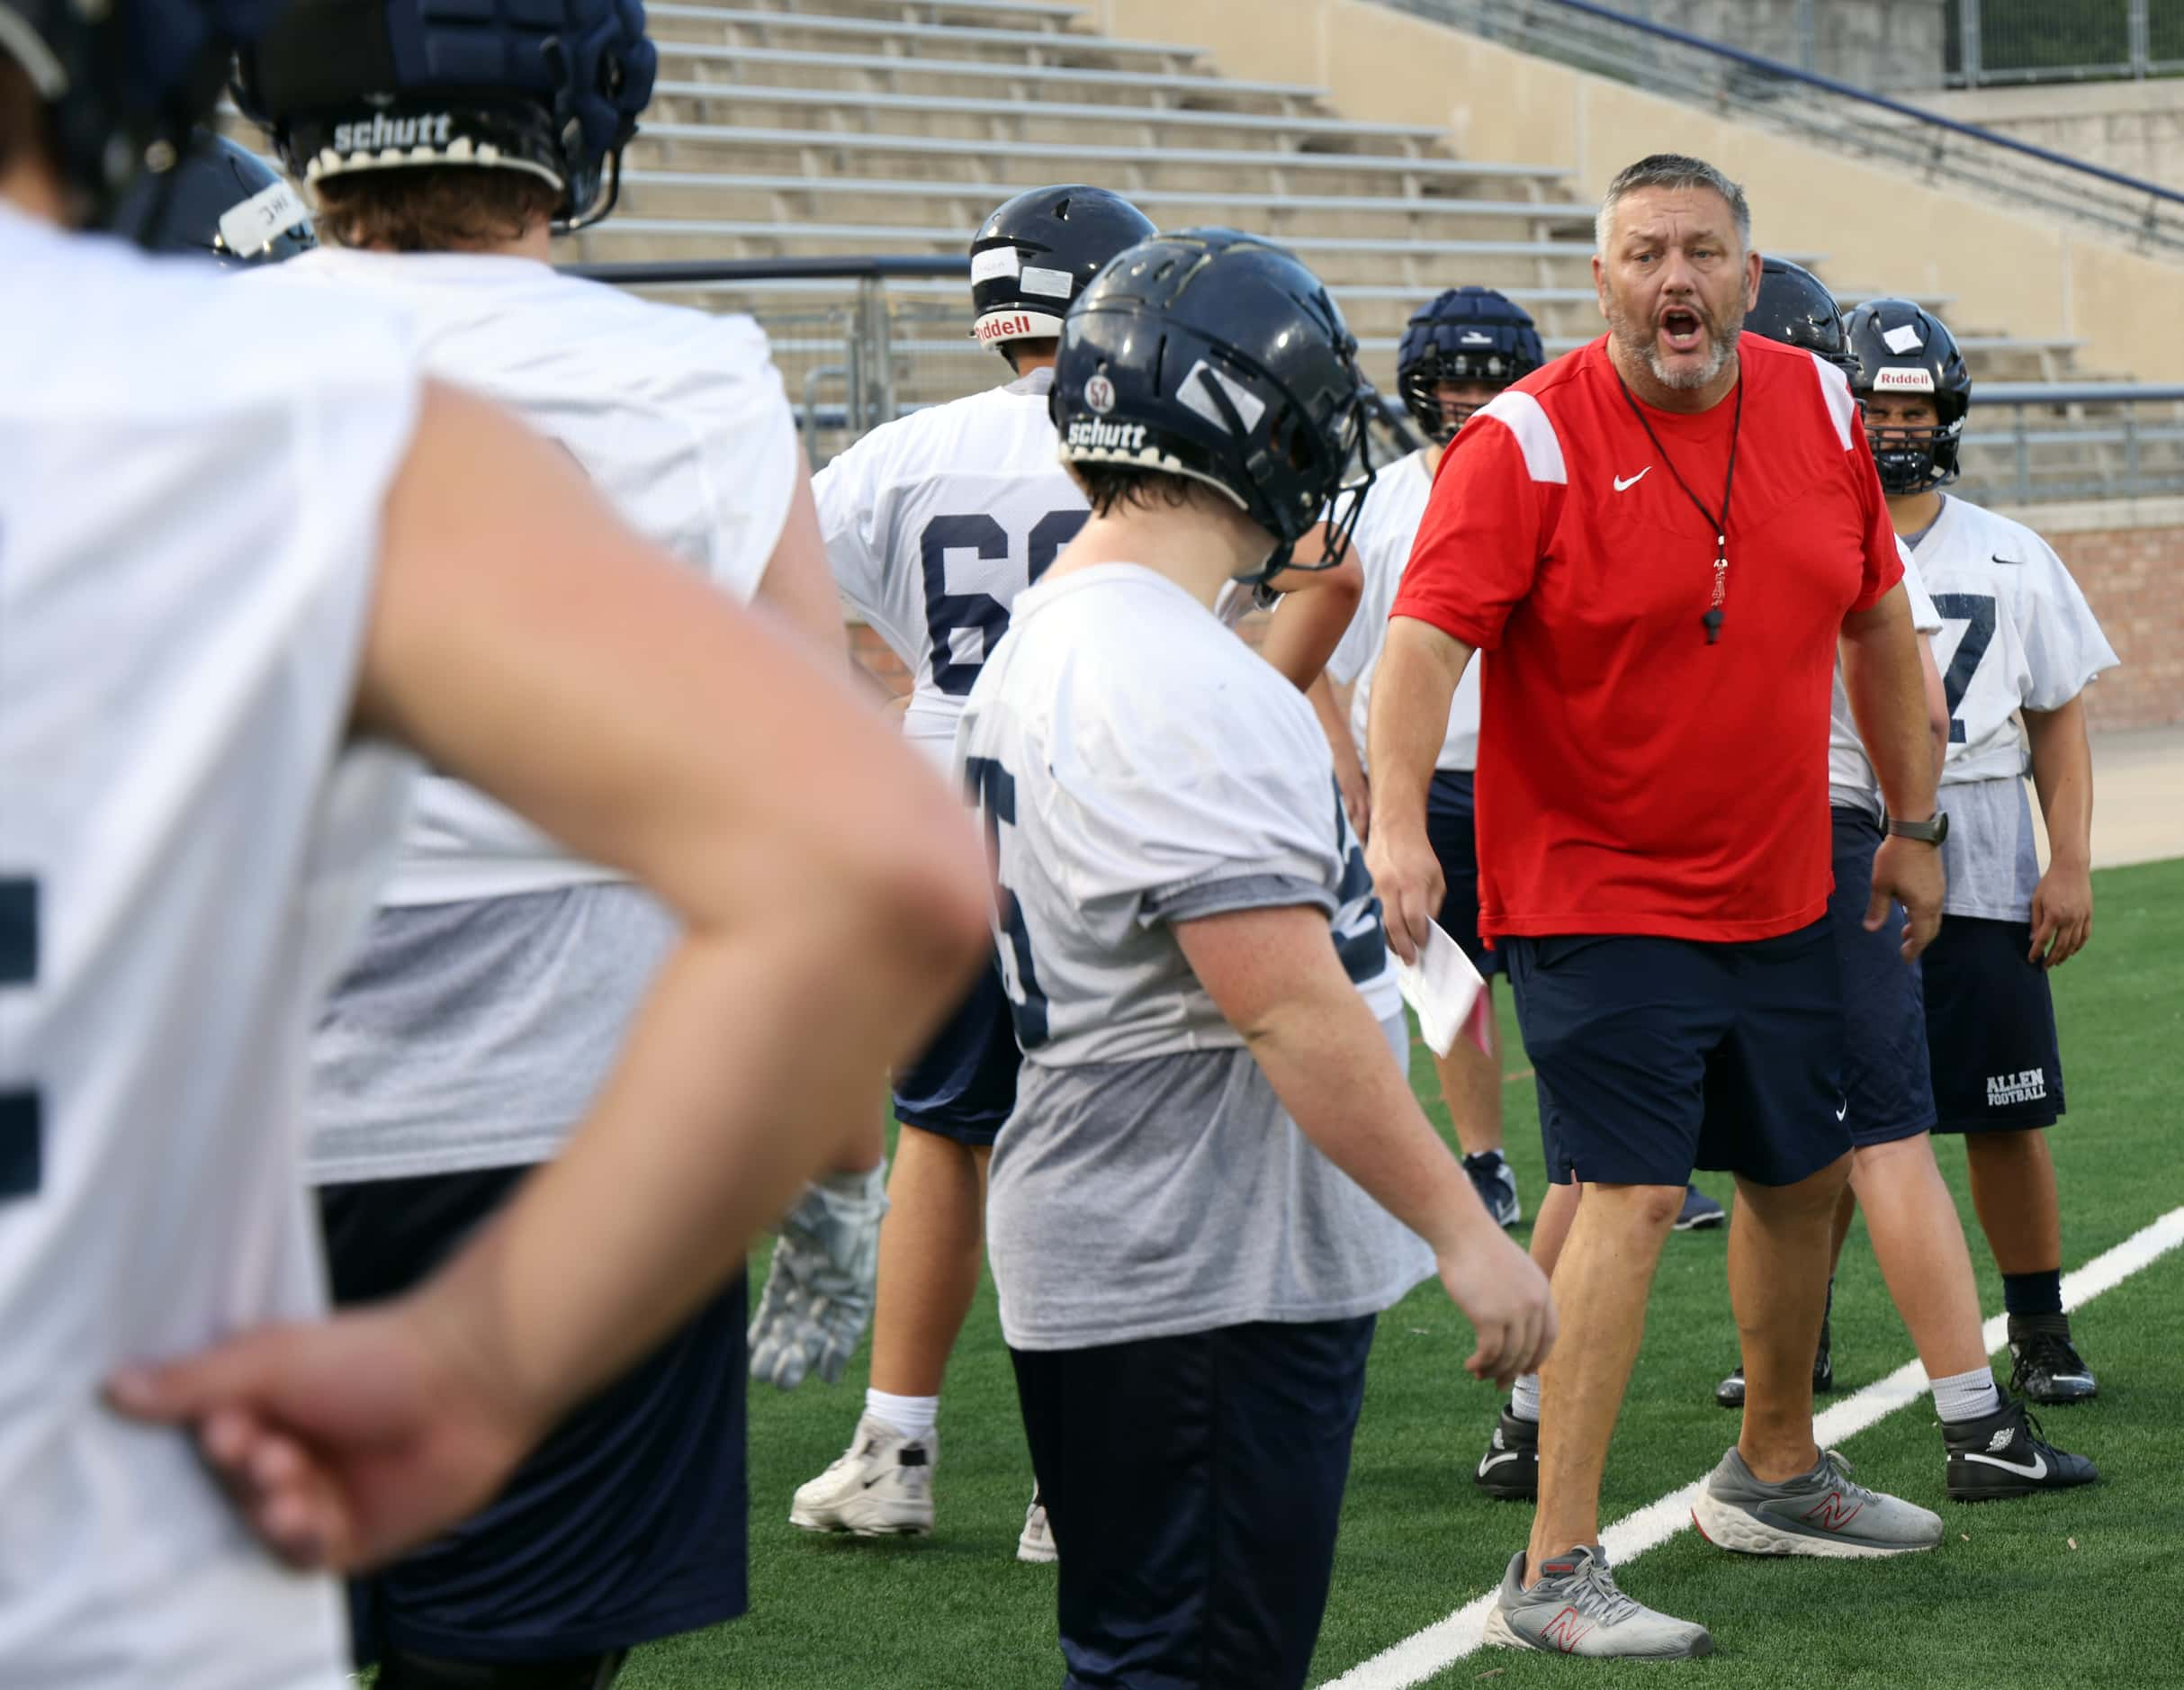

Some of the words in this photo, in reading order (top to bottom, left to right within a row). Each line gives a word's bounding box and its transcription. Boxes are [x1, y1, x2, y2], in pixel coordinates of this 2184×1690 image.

[335, 112, 453, 152] schutt
[1881, 373, 1928, 386] Riddell
[1068, 415, 1146, 449] schutt
[1986, 1067, 2045, 1093] ALLEN
[1987, 1084, 2046, 1106] FOOTBALL
